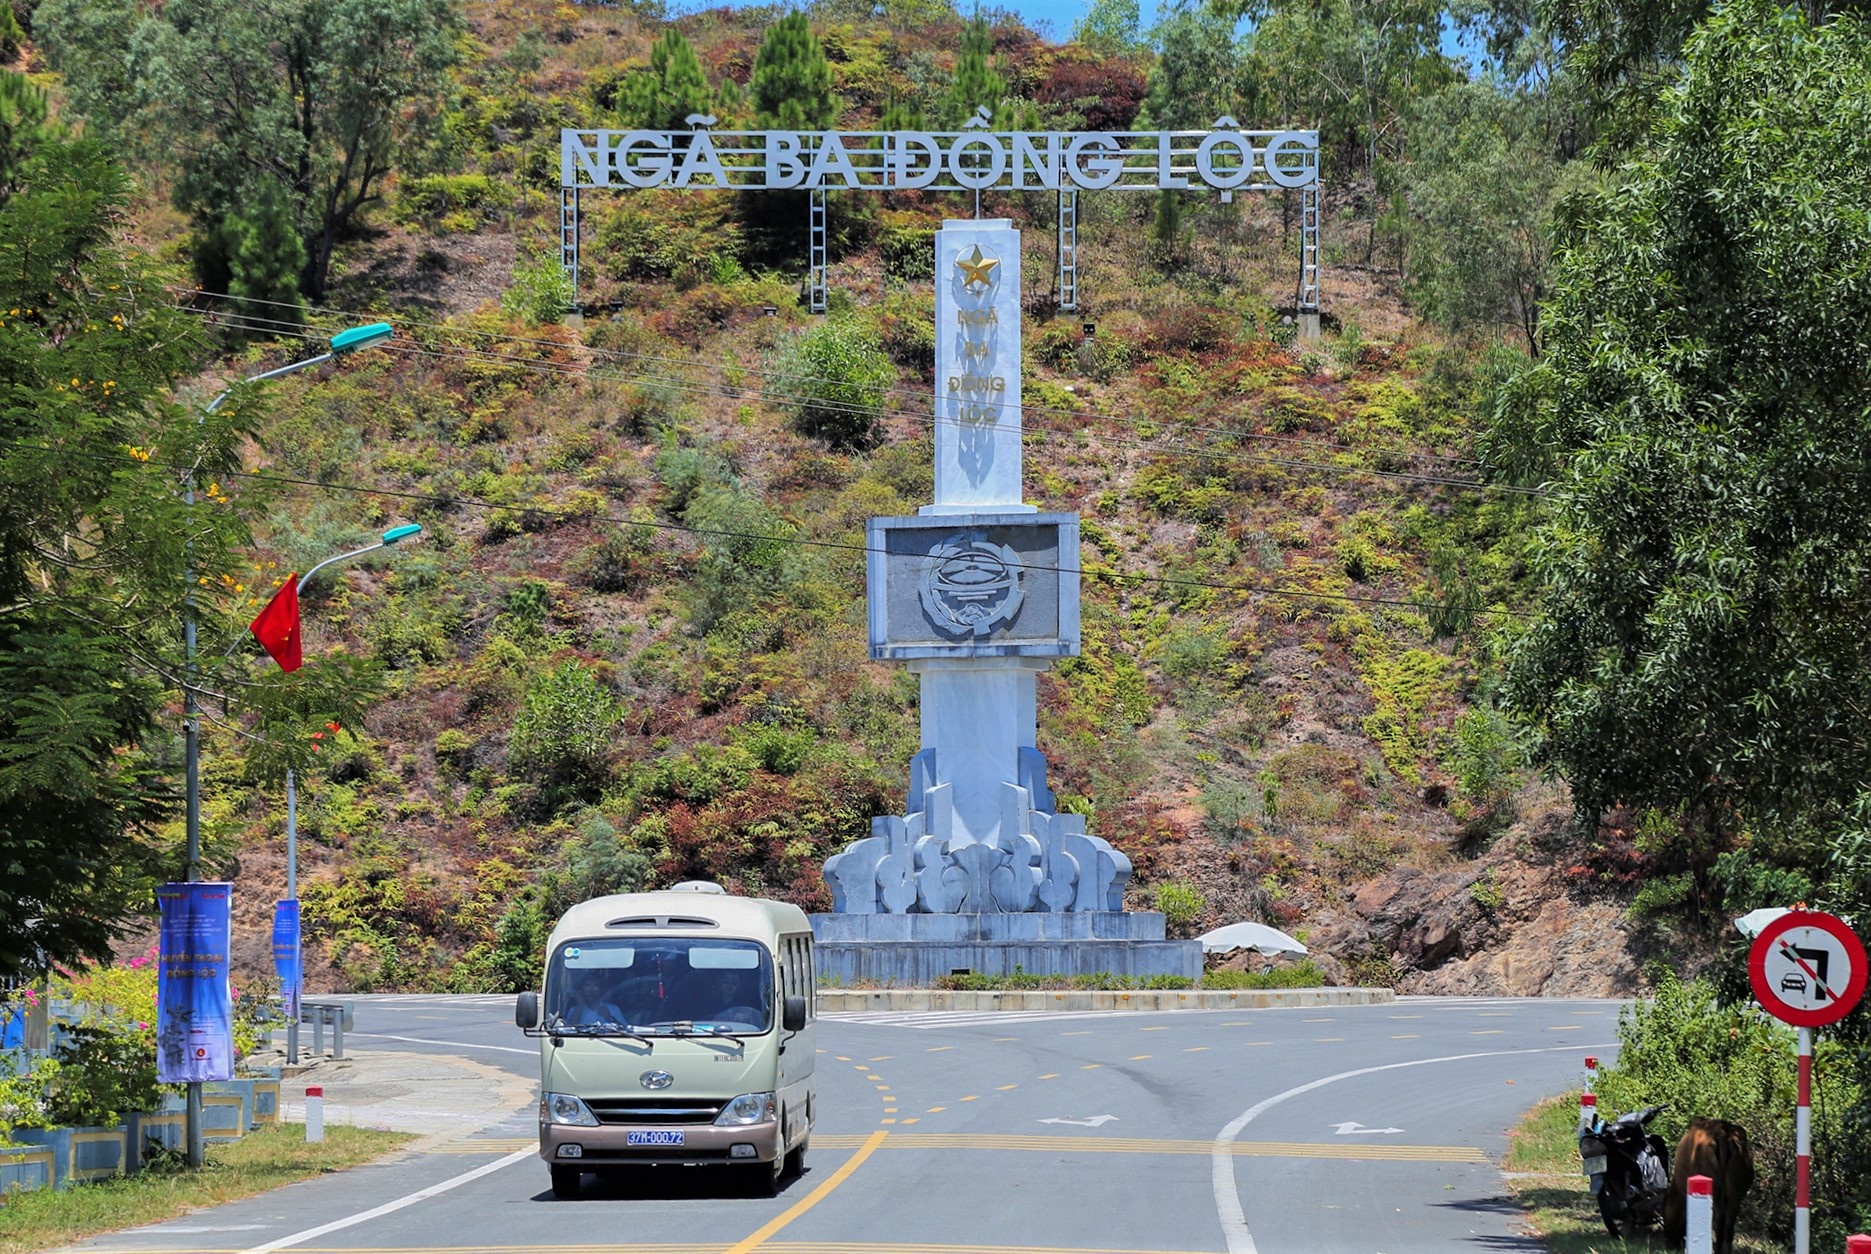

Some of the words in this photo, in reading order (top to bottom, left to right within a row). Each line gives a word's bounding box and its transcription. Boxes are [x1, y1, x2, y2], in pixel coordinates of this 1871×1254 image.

[561, 114, 730, 189] NGÃ
[766, 131, 861, 189] BA
[888, 105, 1123, 190] ĐỒNG
[1159, 115, 1318, 203] LỘC
[957, 306, 999, 324] NGÃ
[965, 341, 989, 358] BA
[629, 1132, 682, 1143] 37M-000.72
